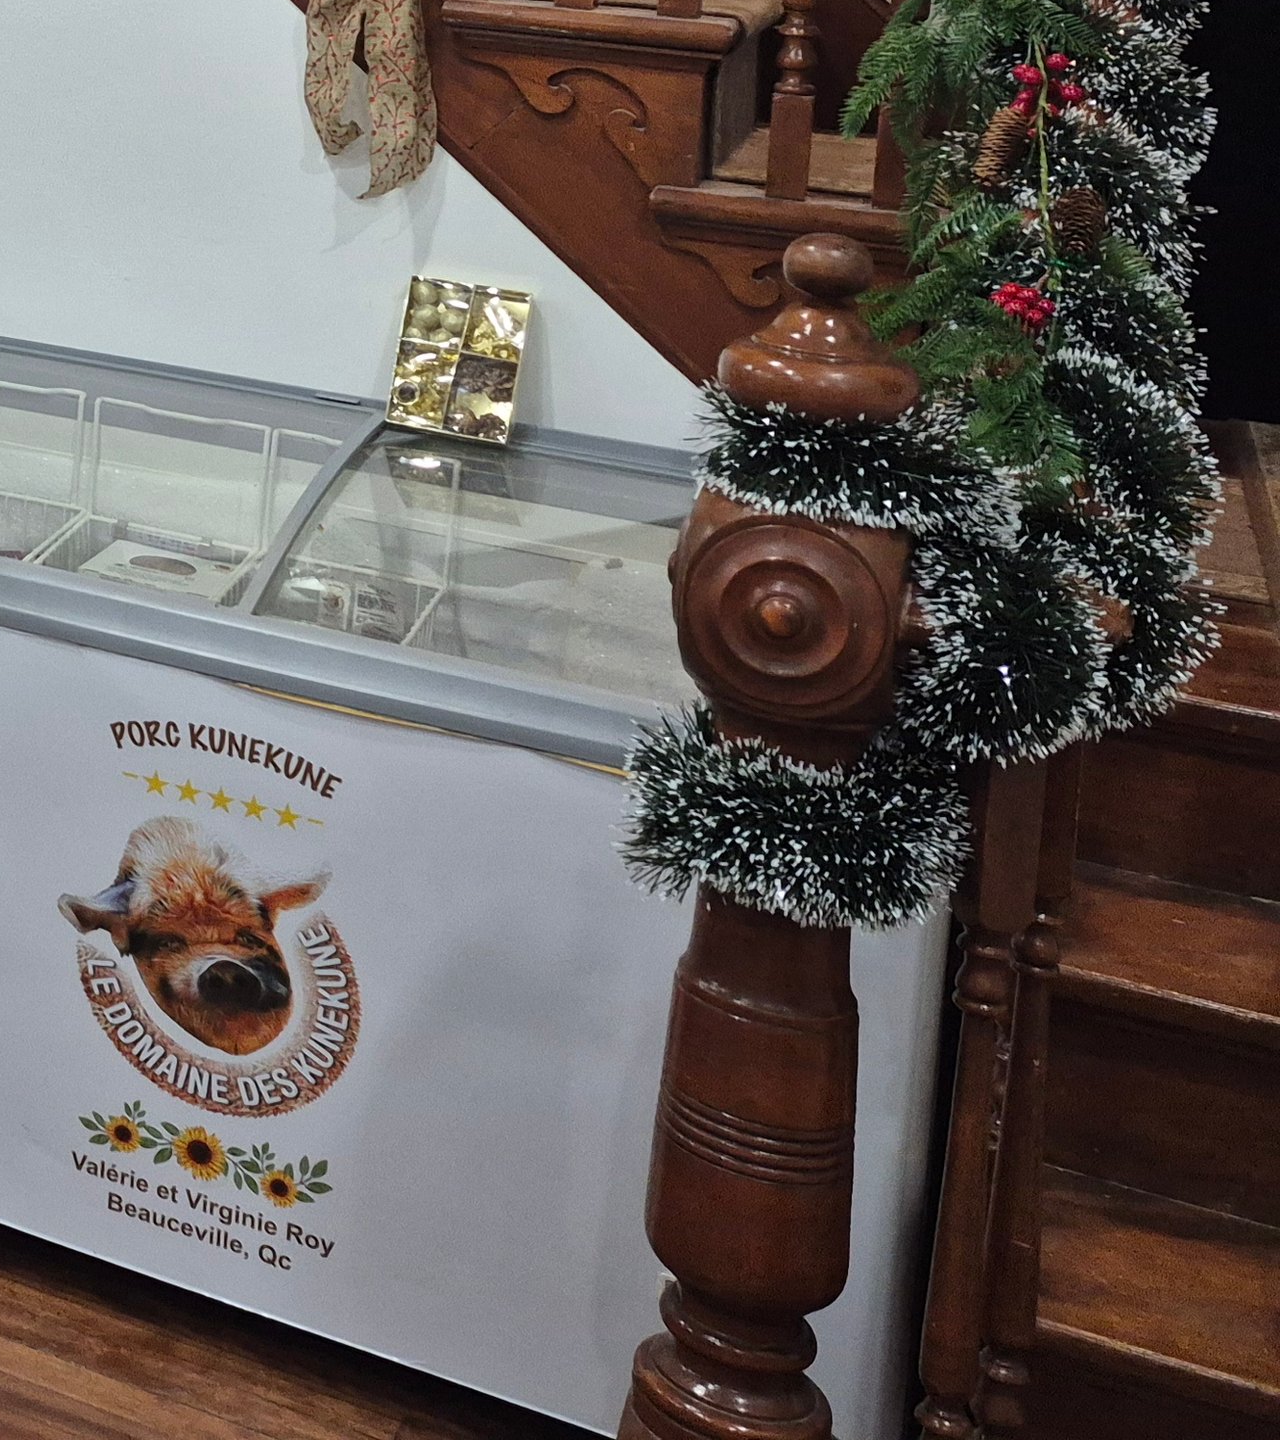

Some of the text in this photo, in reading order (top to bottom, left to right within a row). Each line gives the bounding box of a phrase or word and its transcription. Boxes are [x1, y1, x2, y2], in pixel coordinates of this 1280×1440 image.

[110, 720, 343, 799] PORC KUNEKUNE
[86, 922, 351, 1107] LE DOMAINE DES KUNEKUNE
[71, 1150, 335, 1259] Valérie et Virginie Roy
[107, 1192, 292, 1271] Beauceville, Qc
